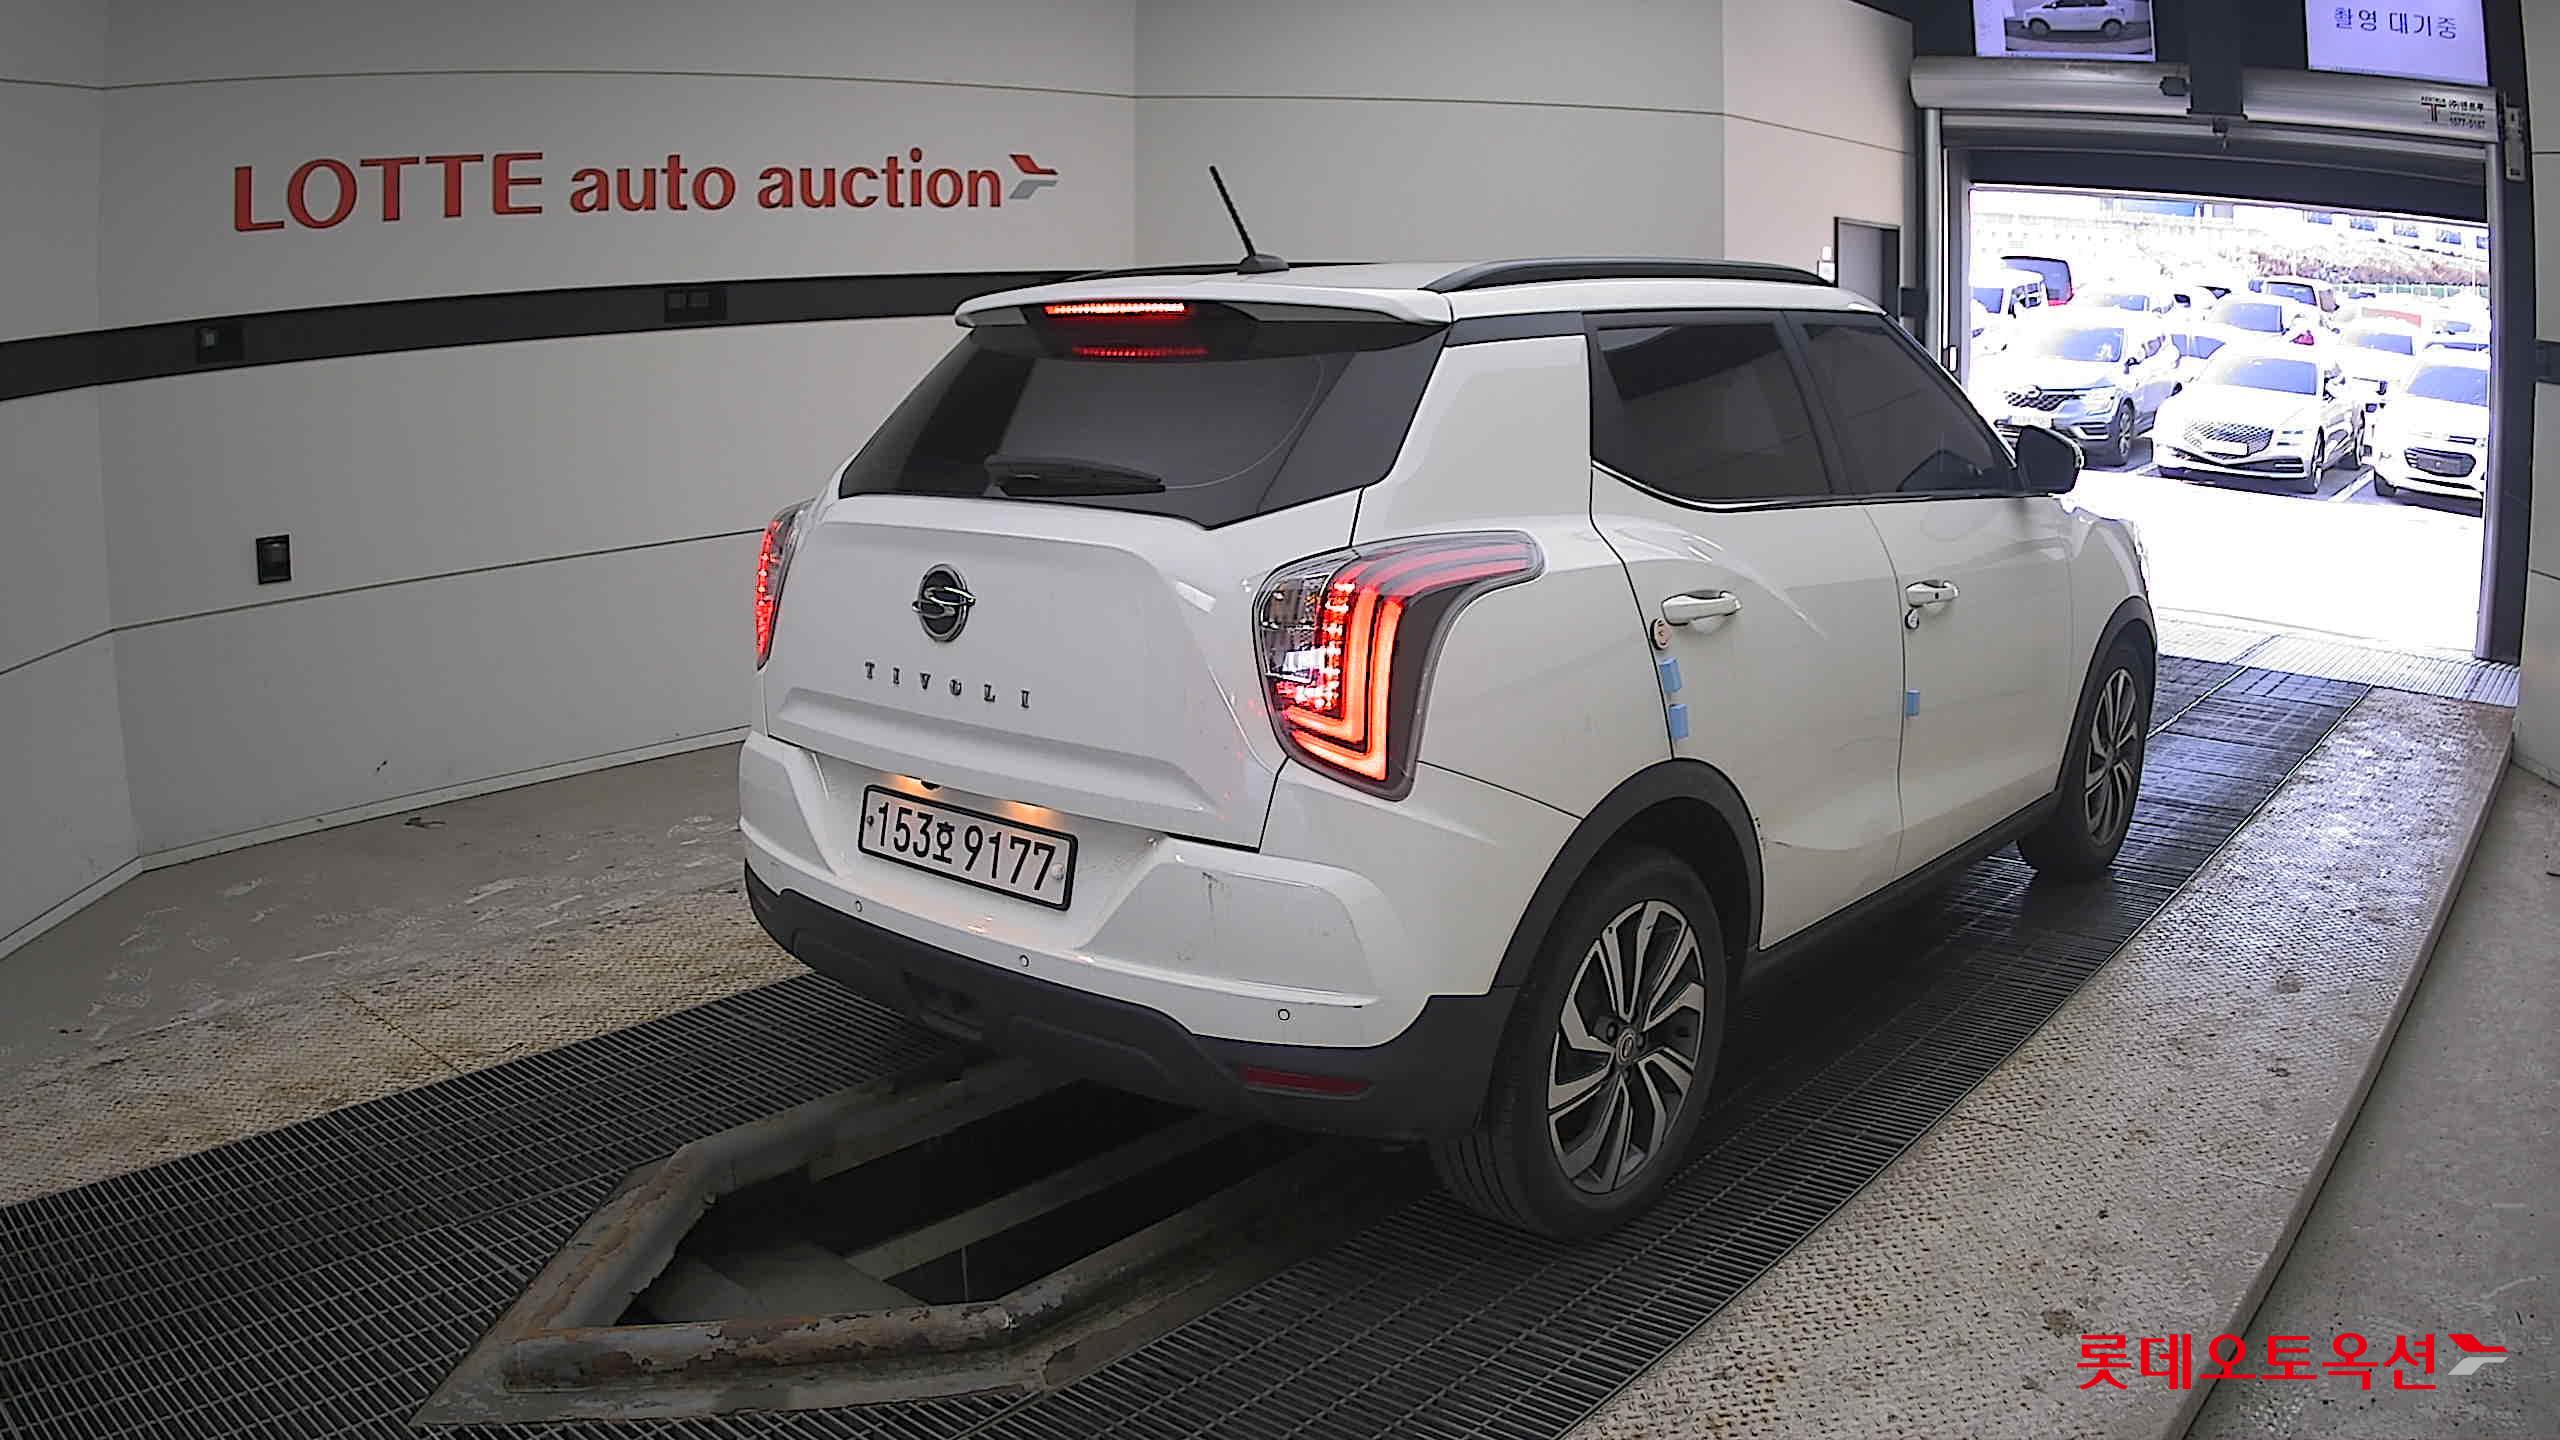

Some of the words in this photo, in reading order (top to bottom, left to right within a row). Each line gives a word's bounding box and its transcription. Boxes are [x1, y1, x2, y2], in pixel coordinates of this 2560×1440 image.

[2390, 12, 2456, 39] 대기중
[235, 152, 543, 232] LOTTE
[569, 154, 735, 213] auto
[757, 148, 1002, 210] auction
[864, 661, 1031, 709] TIVOLI
[963, 825, 1057, 891] 9177
